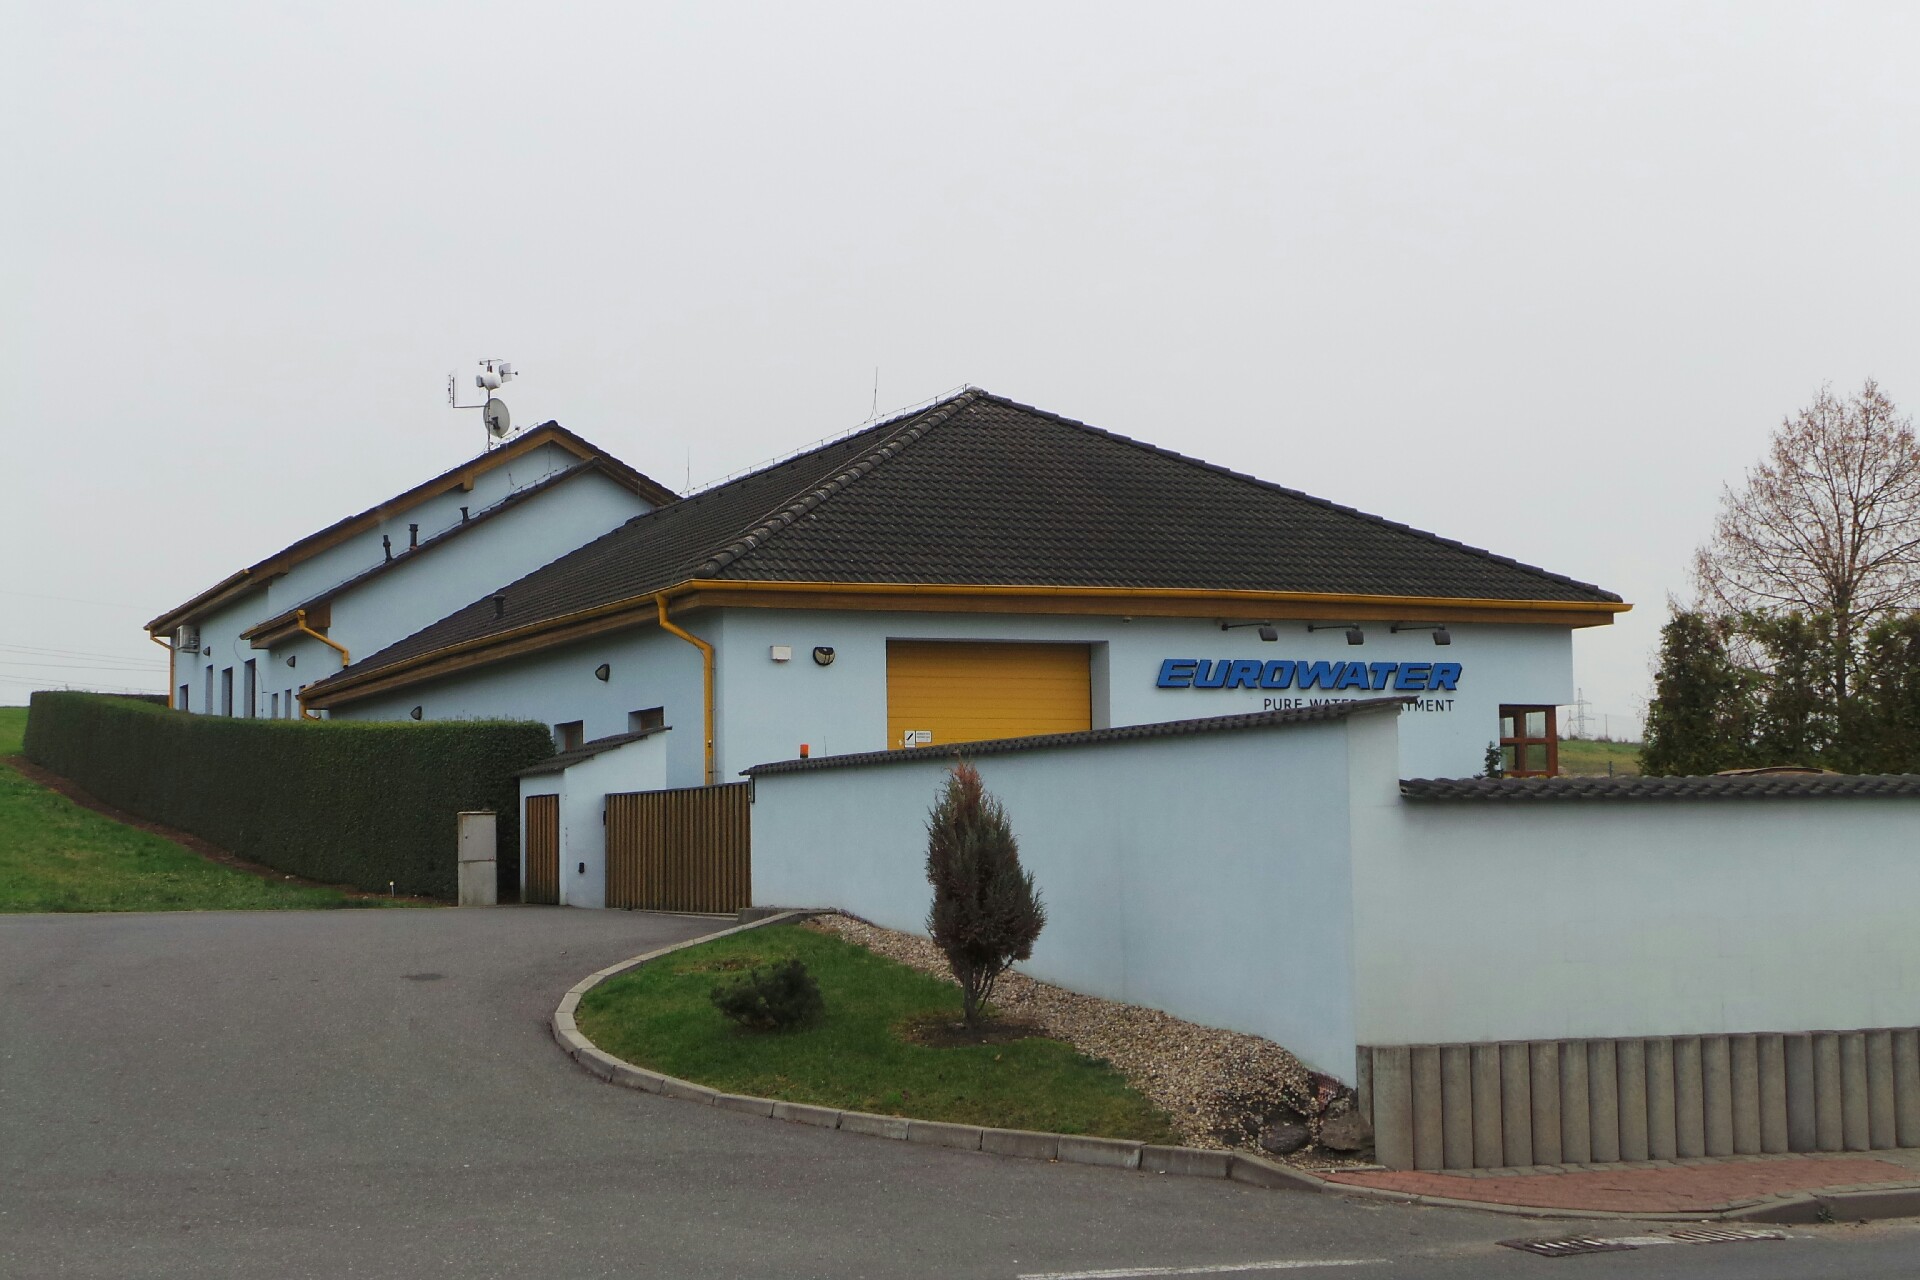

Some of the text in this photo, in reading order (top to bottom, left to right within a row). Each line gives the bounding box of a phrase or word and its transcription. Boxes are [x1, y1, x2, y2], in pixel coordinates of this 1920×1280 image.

[1156, 658, 1463, 691] EUROWATER
[1263, 698, 1302, 711] PURE
[1309, 698, 1358, 707] WAT
